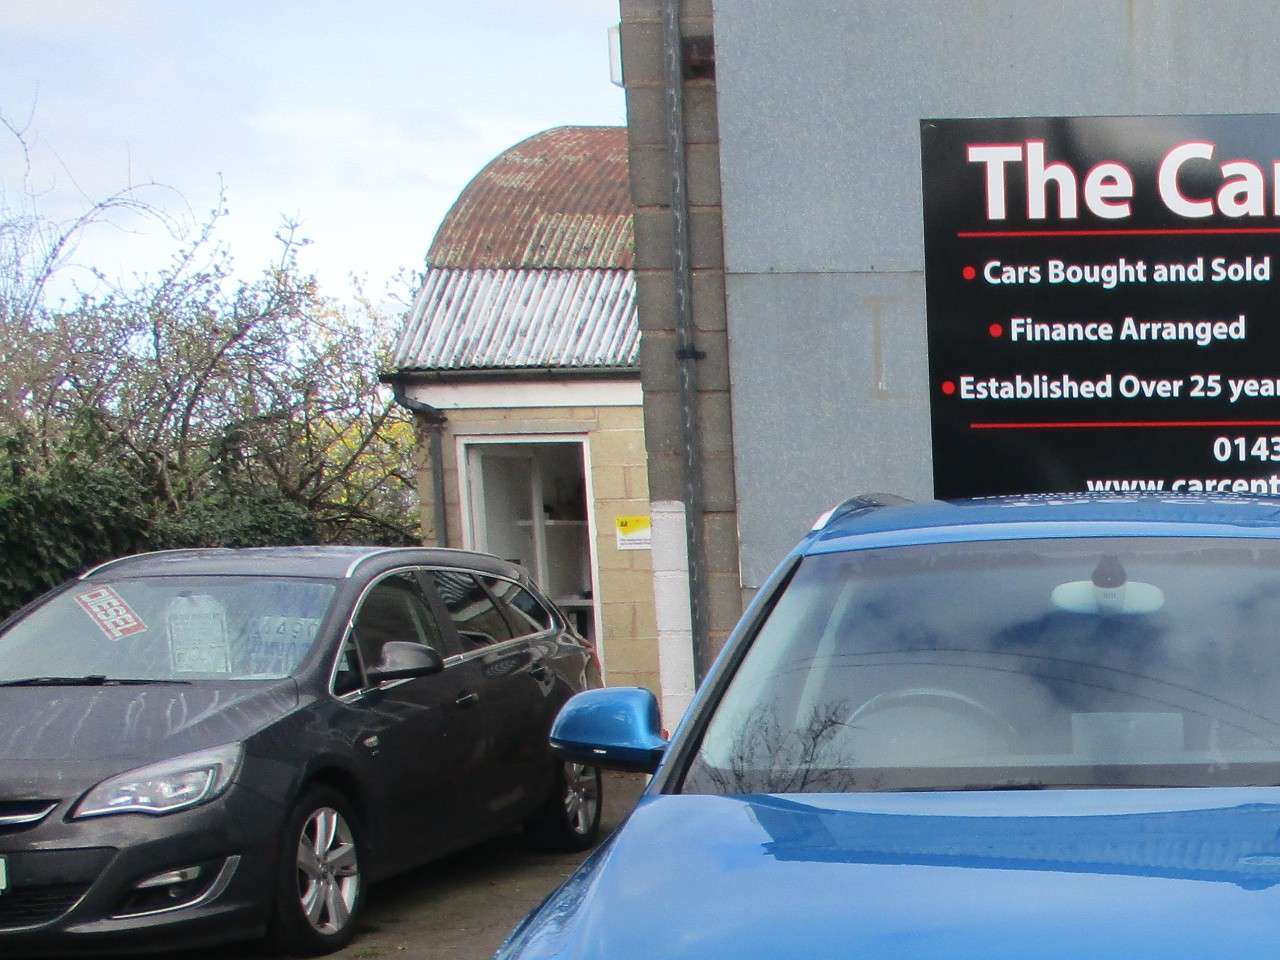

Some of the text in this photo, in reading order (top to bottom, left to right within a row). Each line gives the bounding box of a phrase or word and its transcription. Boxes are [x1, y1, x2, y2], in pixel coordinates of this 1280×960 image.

[966, 140, 1134, 222] The
[983, 256, 1271, 289] Cars Bought and Sold
[1010, 315, 1246, 346] Finance Arranged
[959, 374, 1113, 399] Established
[1118, 375, 1184, 398] Over
[1189, 375, 1222, 397] 25
[79, 589, 138, 638] DIESEL
